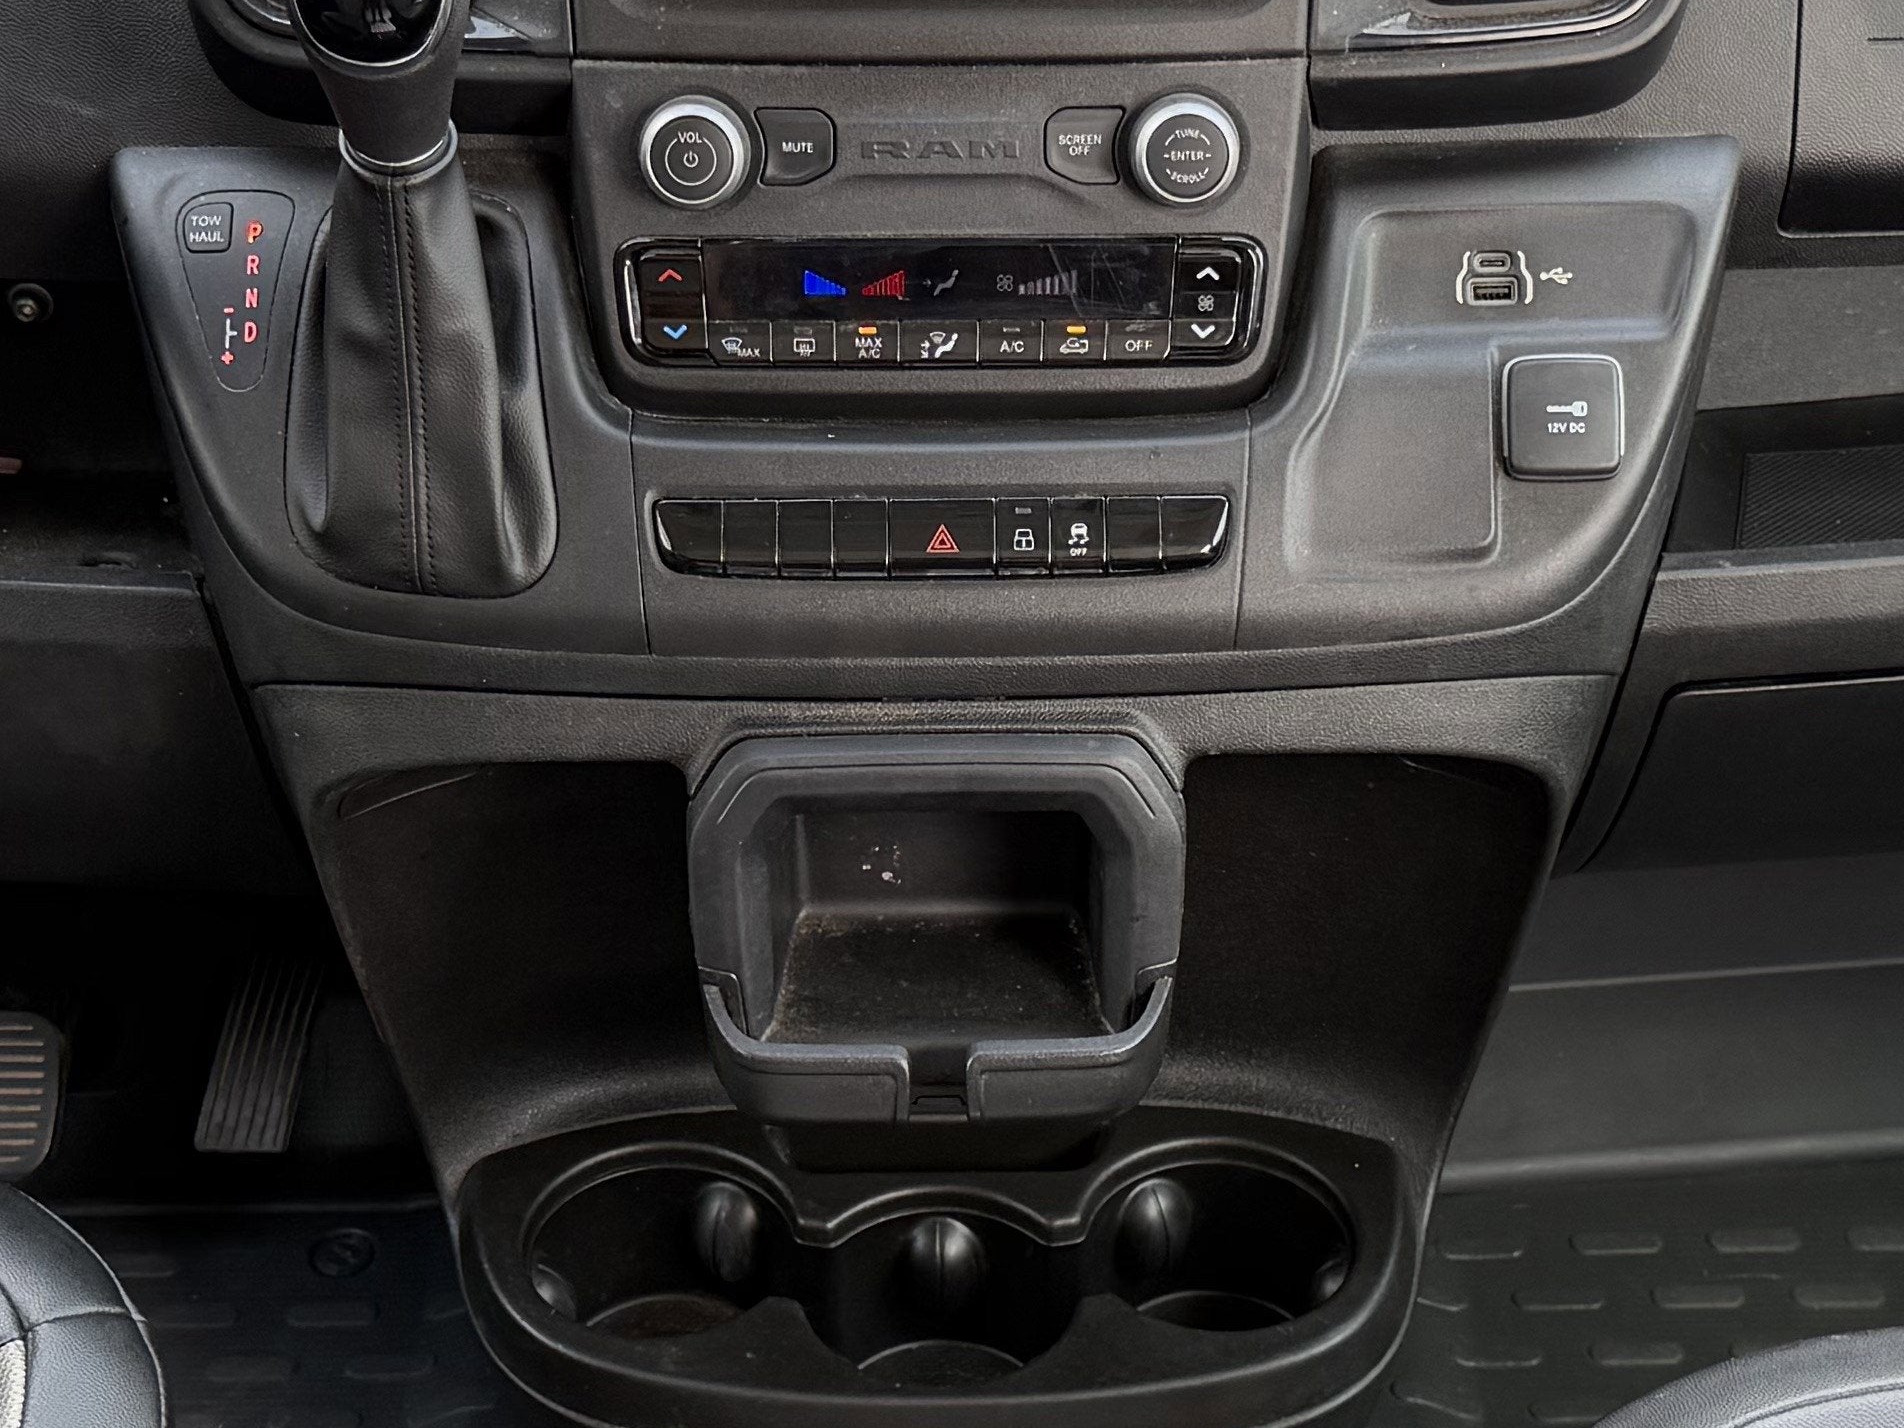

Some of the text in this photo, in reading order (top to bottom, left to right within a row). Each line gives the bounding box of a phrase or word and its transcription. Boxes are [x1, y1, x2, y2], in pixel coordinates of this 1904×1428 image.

[678, 131, 702, 144] VOL
[1058, 133, 1102, 146] SCREEN
[1175, 129, 1200, 139] TUNE
[782, 141, 814, 153] MUTE
[860, 140, 1020, 160] RAM
[1069, 145, 1091, 156] OFF
[1170, 150, 1205, 162] ENTER
[1169, 171, 1206, 184] SCROLL
[191, 215, 222, 227] TOW
[189, 231, 224, 243] HAUL
[247, 220, 264, 244] P
[246, 254, 260, 276] R
[245, 287, 259, 309] N
[243, 321, 258, 344] D
[855, 337, 883, 349] MAX
[1000, 340, 1025, 354] A/C
[1125, 339, 1153, 352] OFF
[738, 348, 761, 358] MAX
[858, 349, 882, 359] A/C
[1547, 422, 1567, 434] 12V
